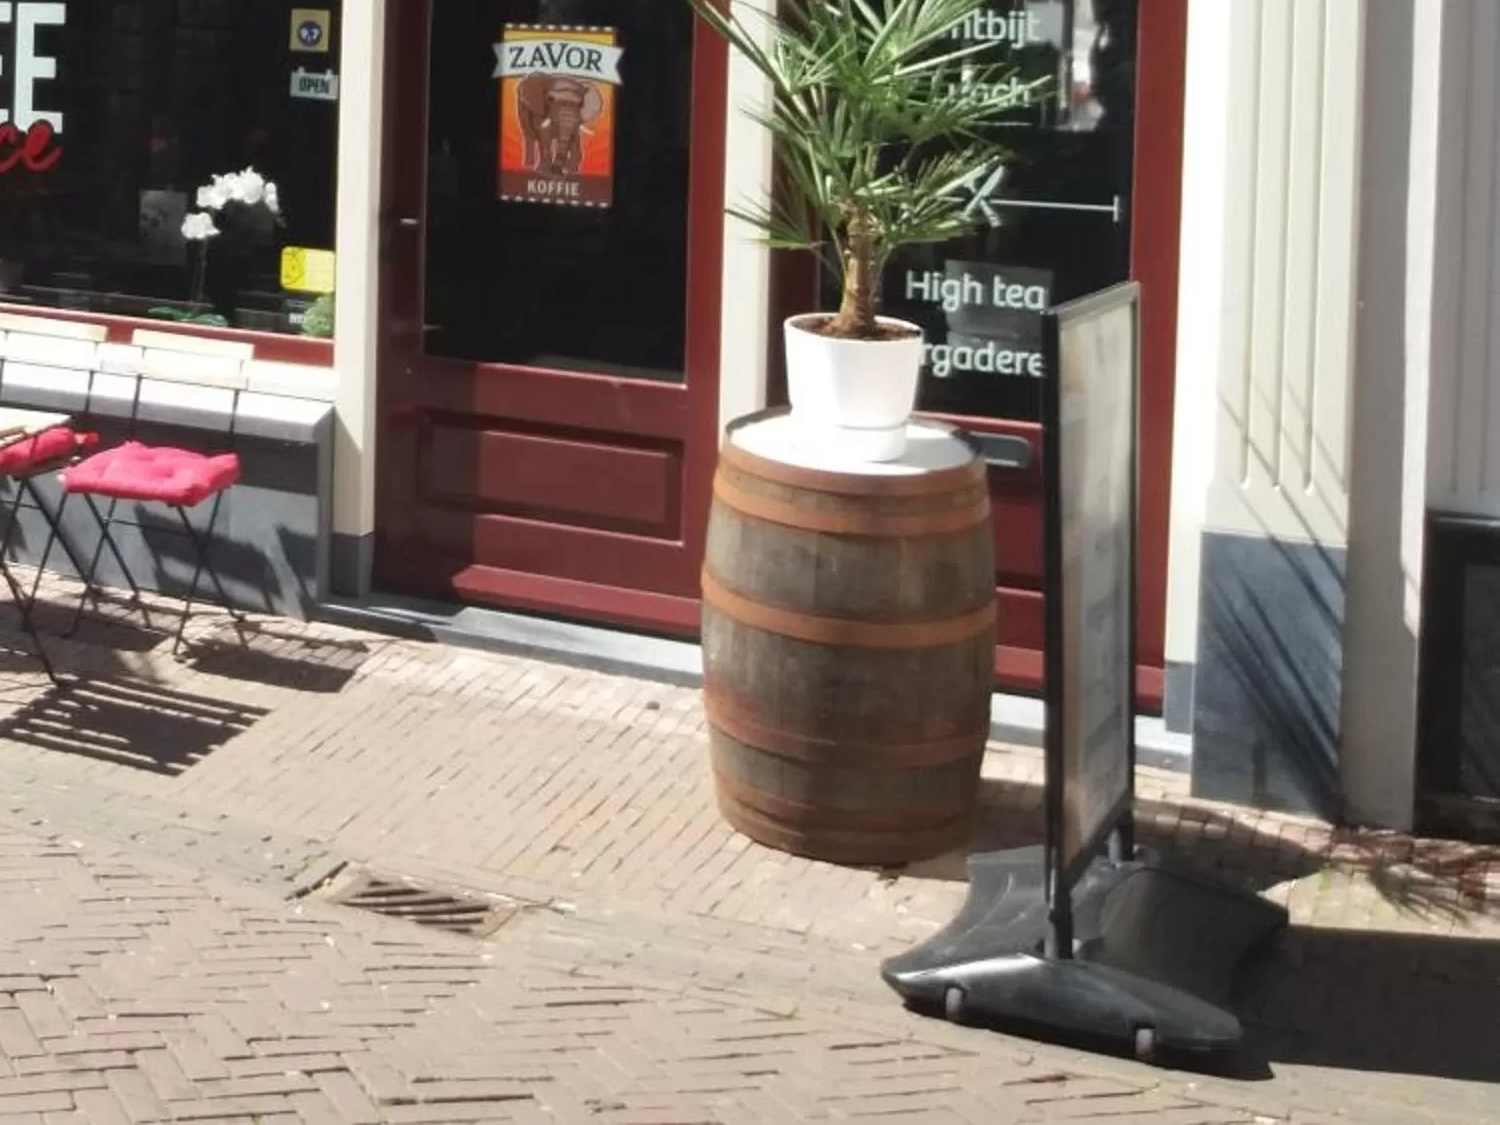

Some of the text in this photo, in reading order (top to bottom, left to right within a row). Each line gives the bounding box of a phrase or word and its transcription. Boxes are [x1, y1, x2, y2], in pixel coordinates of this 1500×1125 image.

[936, 7, 1041, 50] ntbijt
[509, 42, 603, 72] ZAVOR
[527, 179, 581, 196] KOFFIE
[905, 269, 1046, 312] High tea
[920, 341, 1044, 378] rgadere
